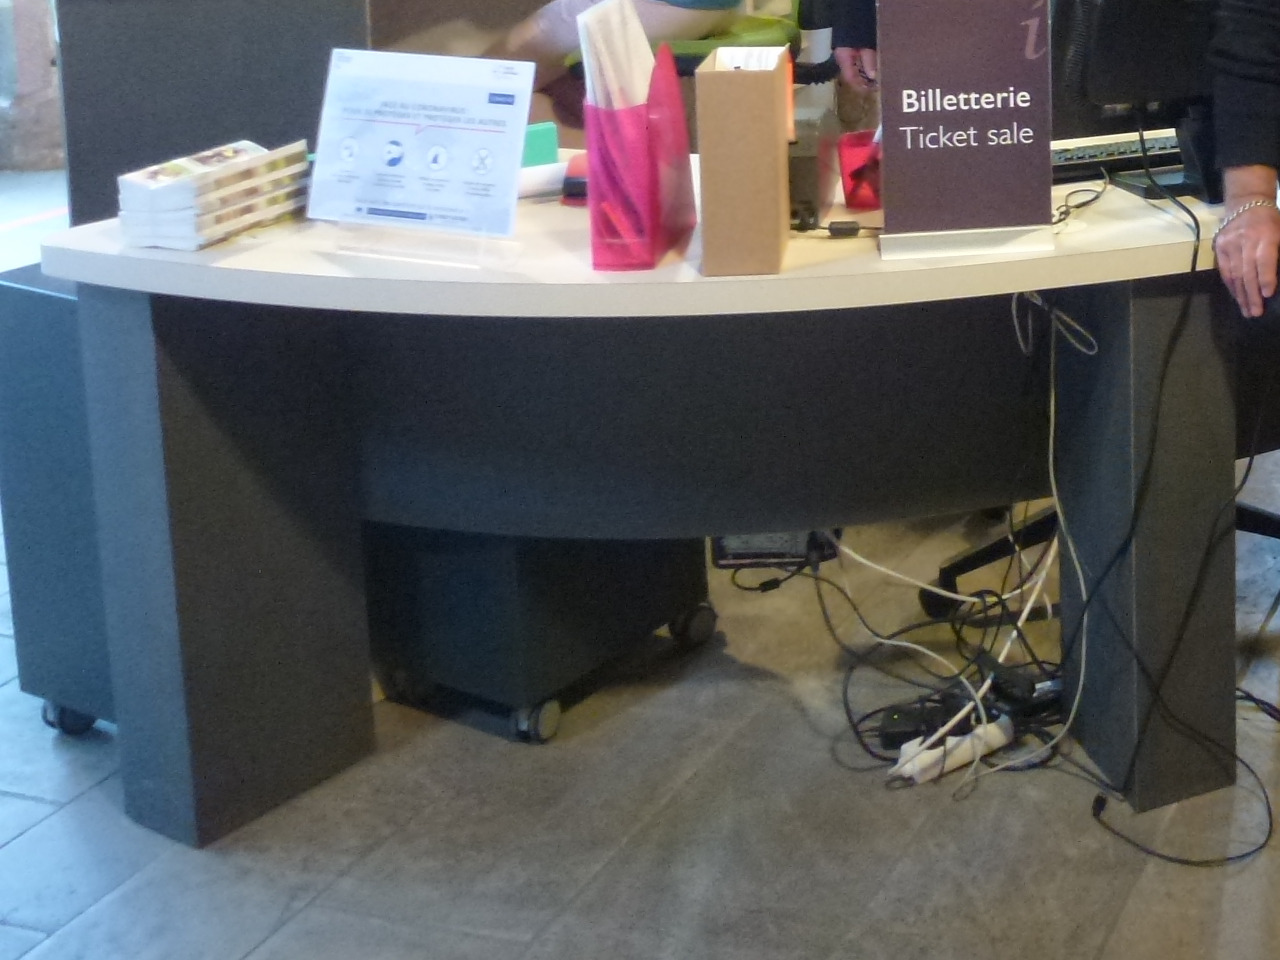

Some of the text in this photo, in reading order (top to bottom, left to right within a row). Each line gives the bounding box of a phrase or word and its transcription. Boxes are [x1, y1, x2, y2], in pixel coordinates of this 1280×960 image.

[901, 86, 1032, 113] Billetterie
[899, 122, 1035, 150] Ticket sale
